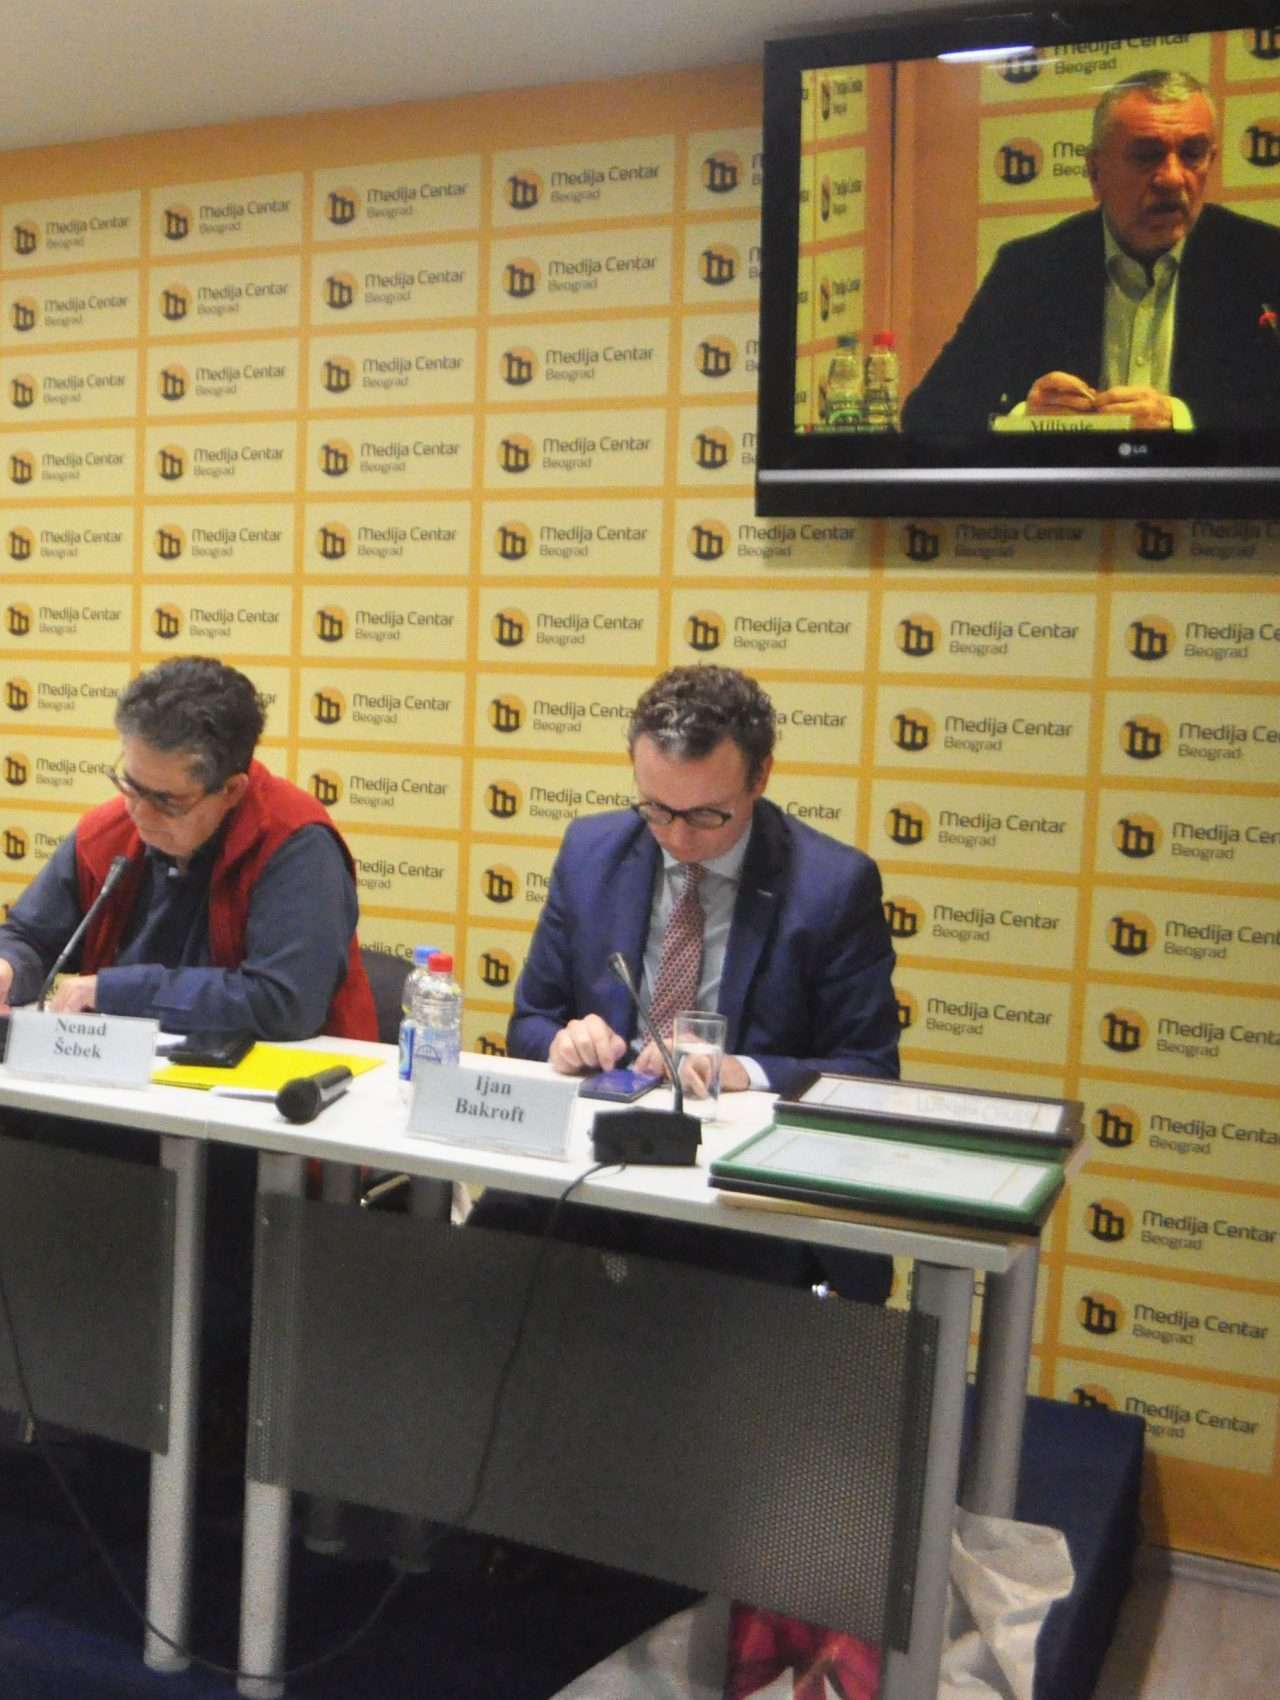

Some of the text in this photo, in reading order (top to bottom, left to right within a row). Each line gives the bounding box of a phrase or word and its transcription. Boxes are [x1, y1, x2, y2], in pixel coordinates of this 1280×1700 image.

[1055, 57, 1117, 75] Beograd
[550, 165, 659, 188] Medija Centar
[366, 183, 467, 204] Medija Centar
[547, 255, 656, 276] Medija Centar
[364, 269, 464, 289] Medija Centar
[362, 355, 462, 374] Medija Centar
[545, 346, 655, 366] Medija Centar
[360, 441, 459, 459] Medija Centar
[542, 436, 651, 455] Medija Centar
[357, 526, 456, 544] Medija Centar
[539, 525, 648, 544] Medija Centar
[737, 526, 855, 544] Medija Centar
[354, 610, 453, 628] Medija Centar
[536, 613, 644, 632] Medija Centar
[733, 616, 851, 636] Medija Centar
[949, 620, 1080, 641] Medija Centar
[1184, 622, 1255, 644] Medija
[733, 636, 787, 651] Beograd
[948, 640, 1008, 657] Beograd
[1183, 643, 1249, 661] Beograd
[352, 693, 452, 712] Medija Centar
[532, 700, 587, 720] Medija
[352, 710, 398, 725] Beograd
[532, 718, 582, 734] Beograd
[790, 709, 846, 727] Centar
[944, 715, 1074, 737] Medija Centar
[1178, 722, 1249, 745] Medija
[943, 735, 1003, 753] Beograd
[1177, 743, 1242, 762] Beograd
[349, 775, 447, 795] Medija Centar
[349, 792, 394, 808] Beograd
[529, 787, 583, 807] Medija
[786, 802, 841, 819] Centar
[938, 810, 1067, 833] Medija Centar
[937, 830, 997, 848] Beograd
[1171, 822, 1242, 846] Medija
[1170, 843, 1235, 861] Beograd
[398, 861, 444, 878] Centar
[931, 904, 1060, 930] Medija Centar
[931, 924, 990, 942] Beograd
[1164, 920, 1234, 945] Medija
[1163, 941, 1227, 960] Beograd
[926, 997, 1053, 1025] Medija Centar
[56, 1017, 107, 1037] Nenad
[925, 1017, 984, 1035] Beograd
[1156, 1018, 1226, 1043] Medija
[53, 1036, 102, 1059] Šebek
[1155, 1038, 1219, 1058] Beograd
[475, 1075, 512, 1097] Ijan
[455, 1097, 524, 1122] Bakroft
[1149, 1115, 1218, 1141] Medija
[1148, 1134, 1211, 1155] Beograd
[1141, 1210, 1278, 1244] Medija Centar
[1140, 1229, 1203, 1251] Beograd
[1133, 1304, 1269, 1341] Medija Centar
[1125, 1396, 1257, 1434] Medija Centar
